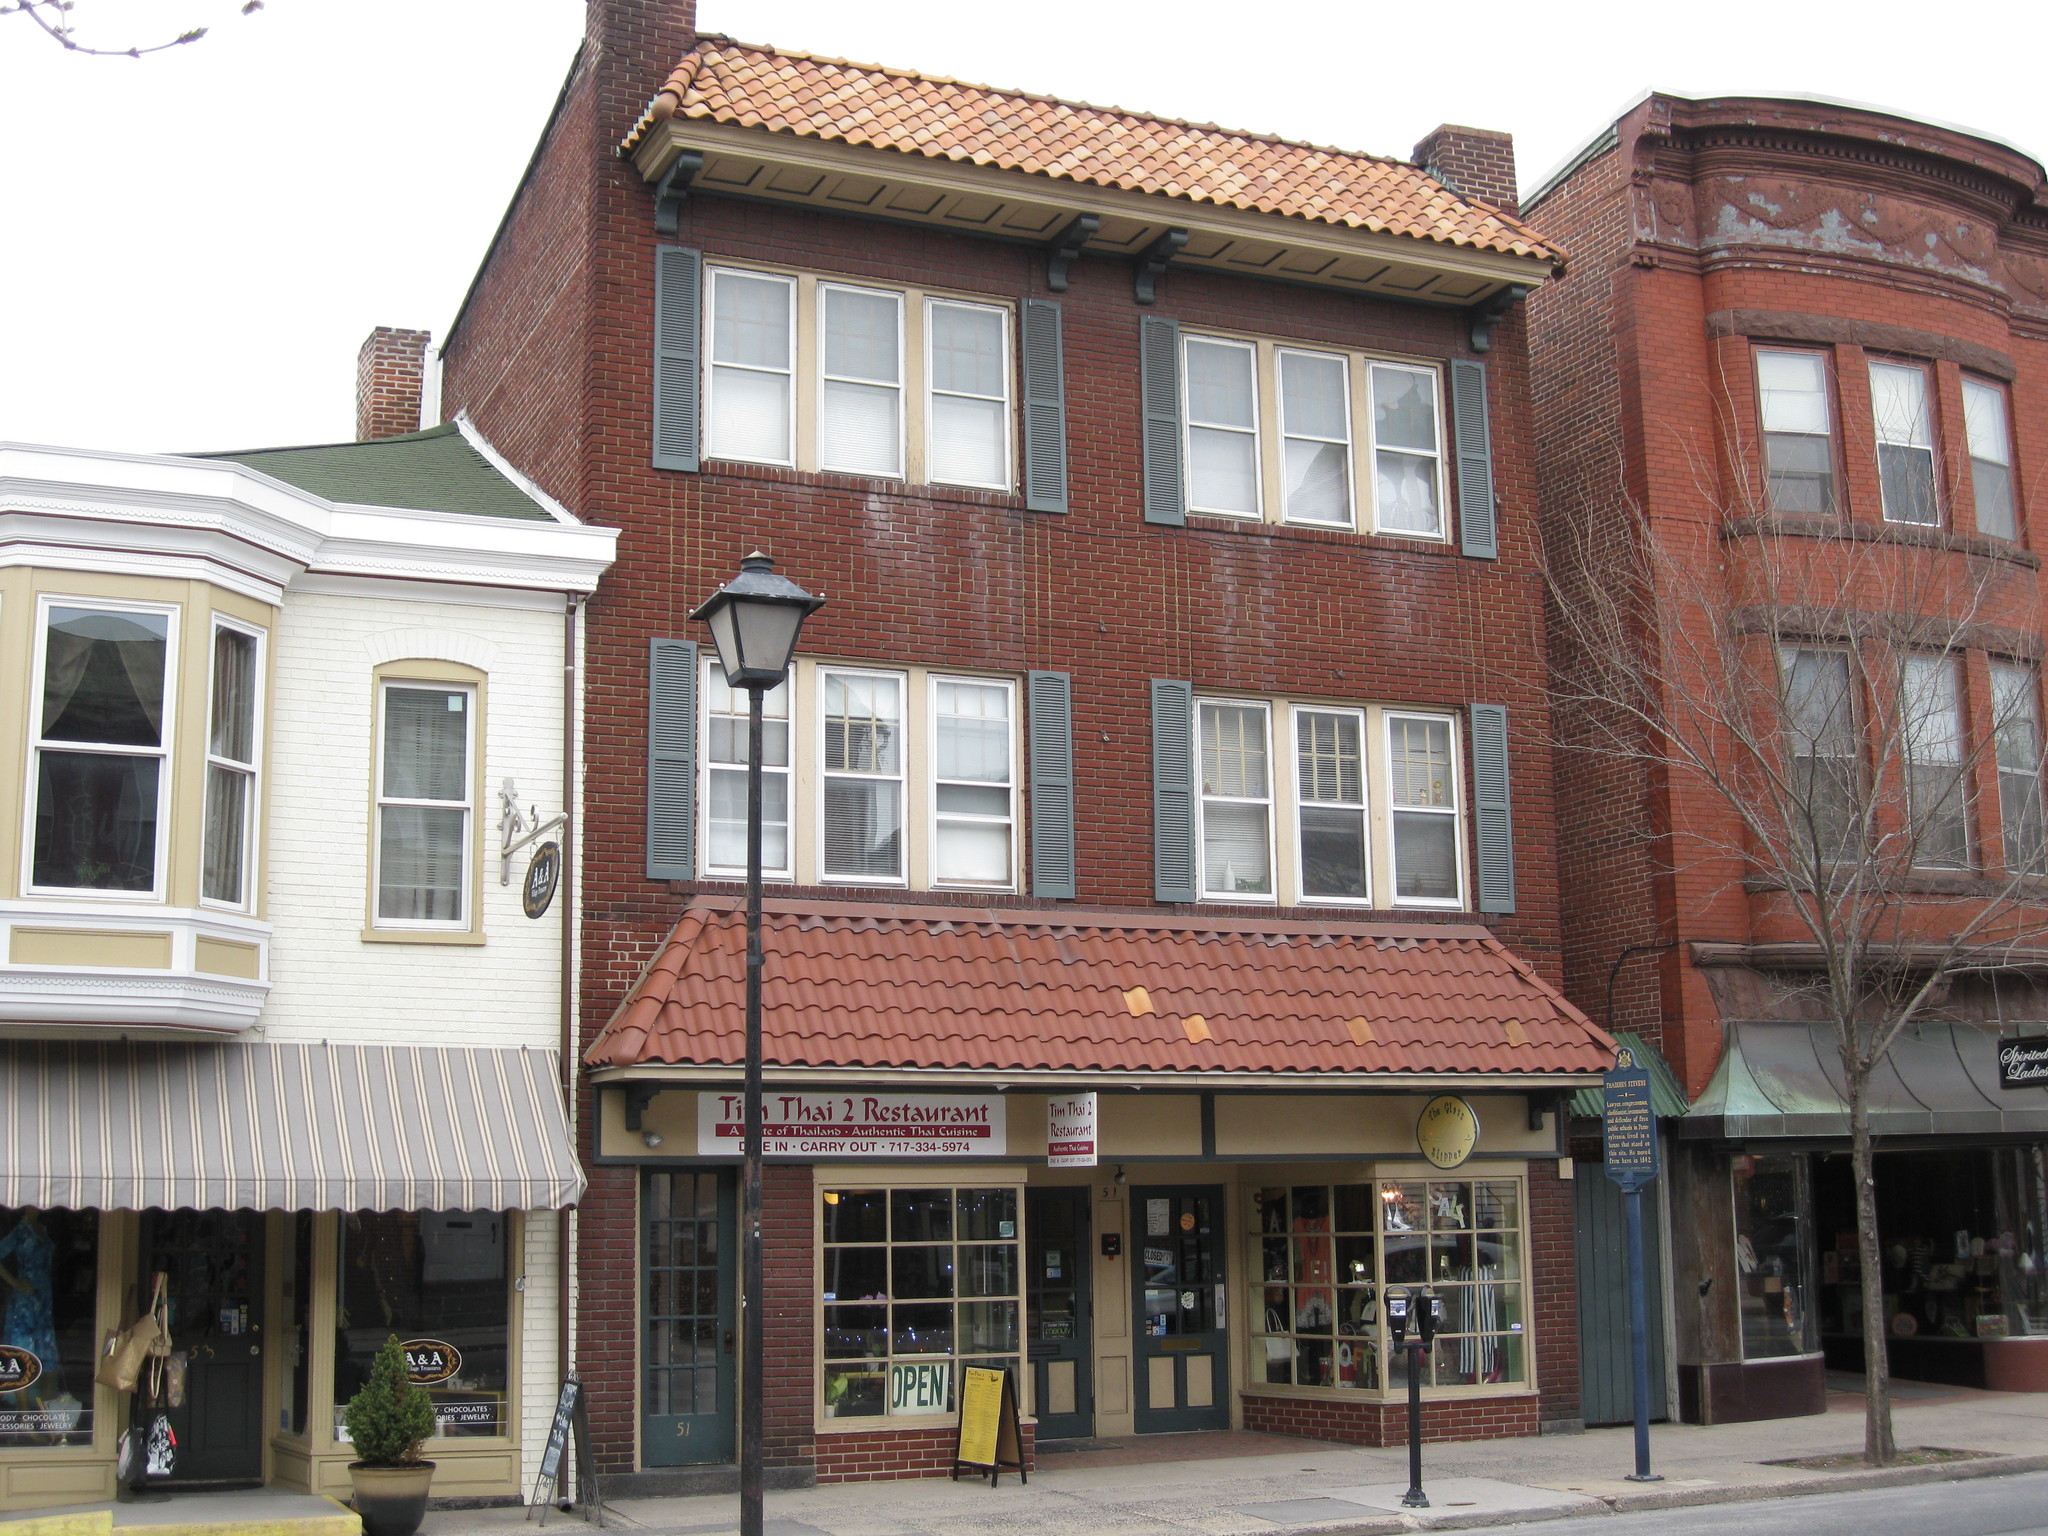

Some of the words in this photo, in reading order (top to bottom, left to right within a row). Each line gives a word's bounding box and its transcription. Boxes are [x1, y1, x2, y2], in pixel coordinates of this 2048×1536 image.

[2000, 1045, 2048, 1066] Spirited
[2006, 1062, 2048, 1080] Ladies
[778, 1096, 833, 1122] Thai
[843, 1098, 854, 1122] 2
[862, 1097, 989, 1123] Restaurant
[1049, 1103, 1065, 1118] Tim
[1067, 1101, 1085, 1117] Thai
[1088, 1101, 1092, 1116] 2
[729, 1126, 740, 1136] A
[776, 1126, 789, 1136] of
[791, 1125, 842, 1136] Thailand
[851, 1126, 906, 1137] Authentic
[909, 1126, 935, 1137] Thai
[938, 1126, 978, 1137] Cuisine
[1050, 1122, 1092, 1137] Restaurant
[775, 1142, 788, 1152] IN
[800, 1142, 846, 1152] CARRY
[850, 1142, 877, 1152] OUT
[889, 1142, 971, 1152] 717-334-5974
[190, 1345, 214, 1359] 53
[406, 1351, 416, 1366] A
[418, 1354, 428, 1365] &
[430, 1351, 443, 1365] A
[8, 1358, 21, 1373] A
[892, 1365, 944, 1408] OPEN
[444, 1405, 487, 1413] CHOCOLATES
[22, 1413, 71, 1421] CHOCOLATES
[460, 1413, 490, 1421] JEWELRY
[676, 1422, 690, 1436] 51
